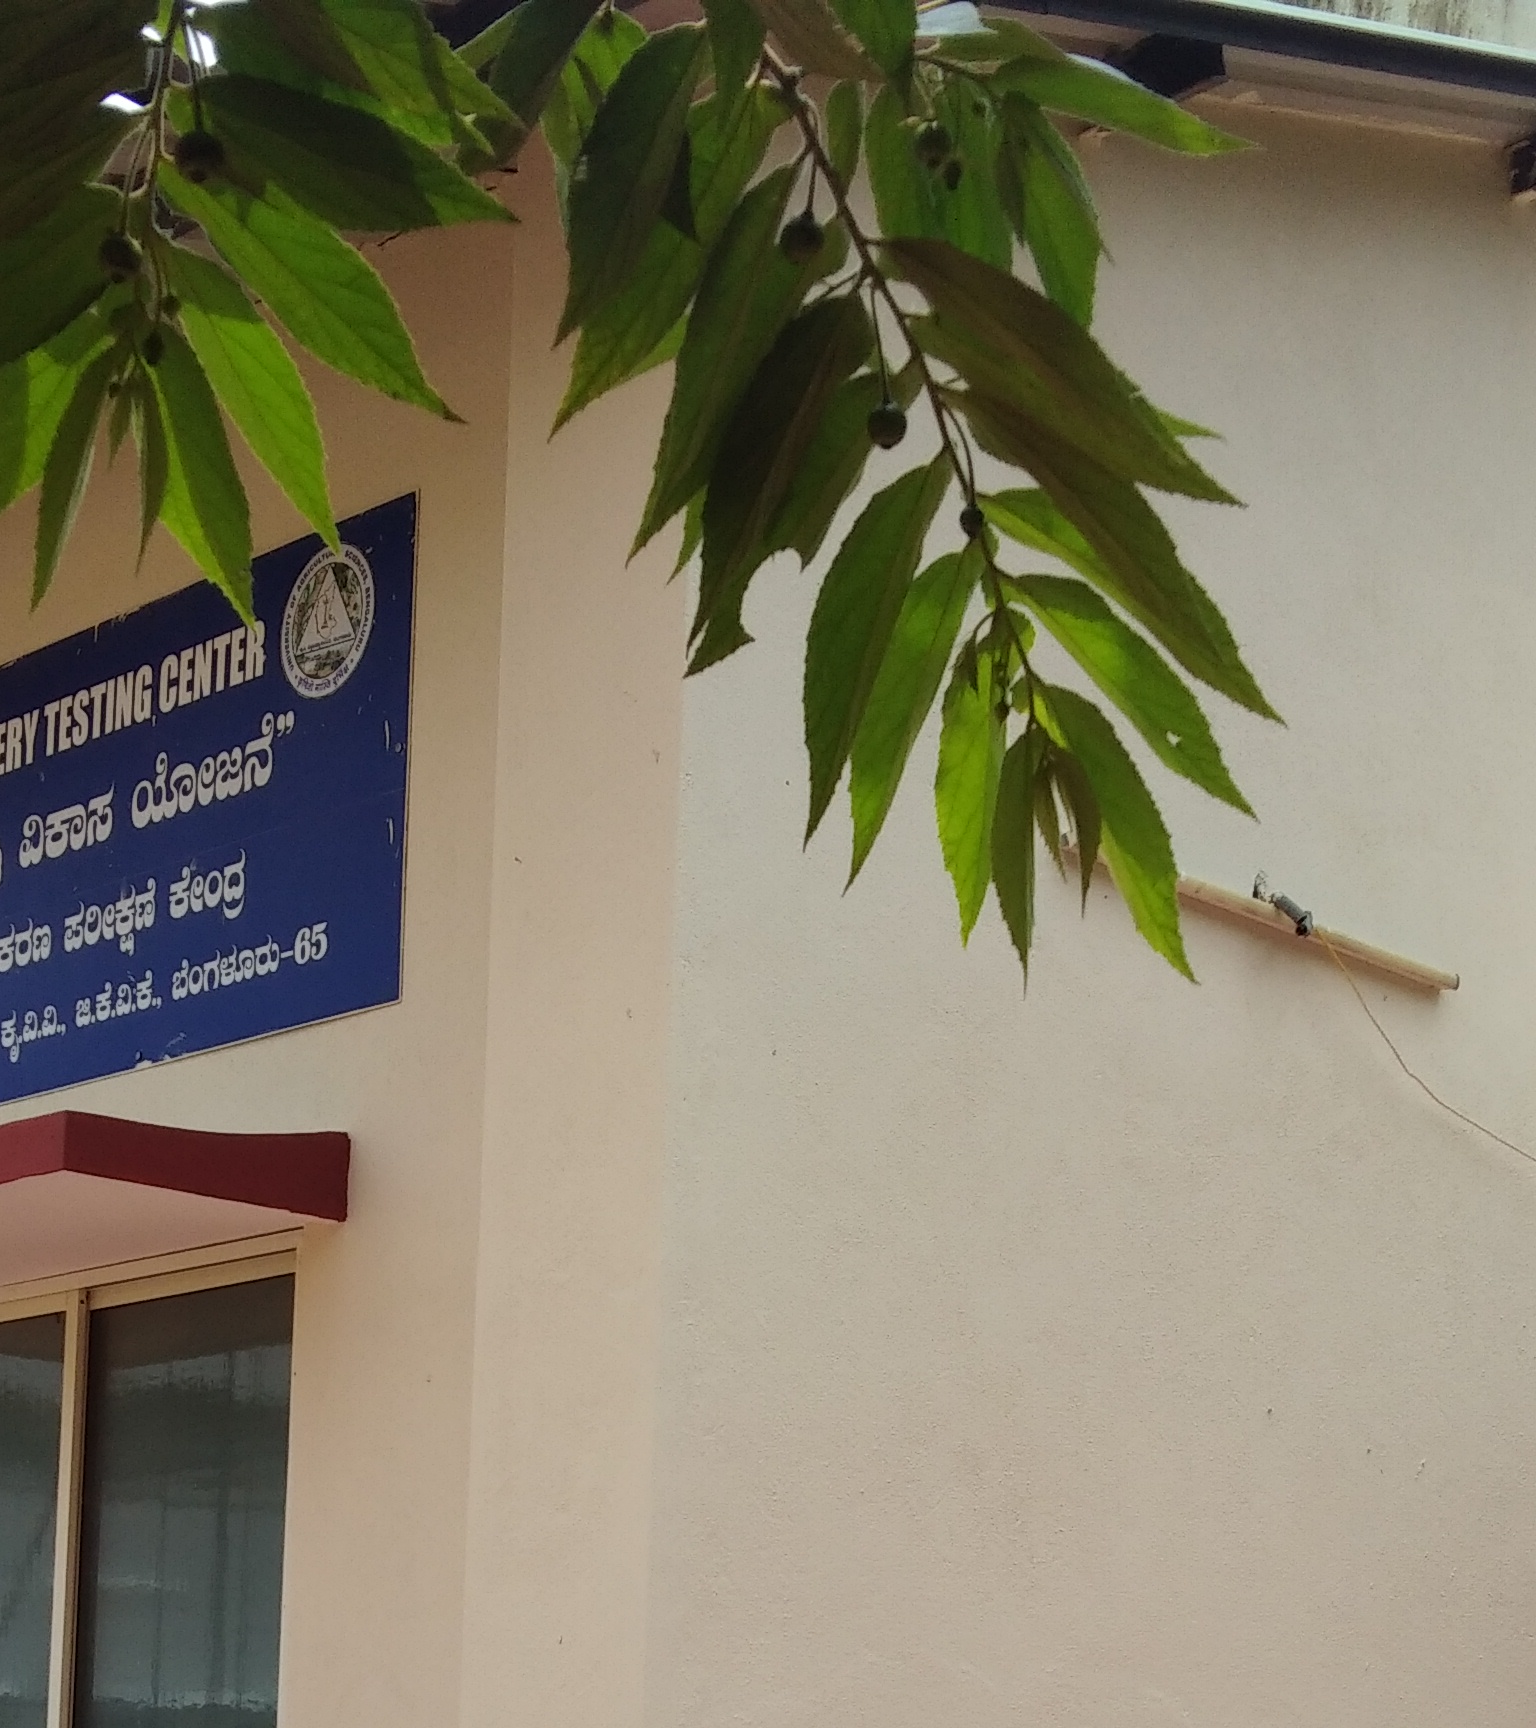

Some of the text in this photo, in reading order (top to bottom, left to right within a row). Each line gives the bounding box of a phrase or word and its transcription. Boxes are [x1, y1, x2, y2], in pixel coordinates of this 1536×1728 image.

[289, 594, 298, 610] OF
[44, 664, 153, 757] TESTING
[158, 620, 266, 713] CENTER
[18, 783, 115, 868] ವಿಕಾಸ
[64, 877, 156, 957] ಪರೀಕ್ಷಣೆ
[168, 848, 246, 919] ಕೇಂದ್ರ
